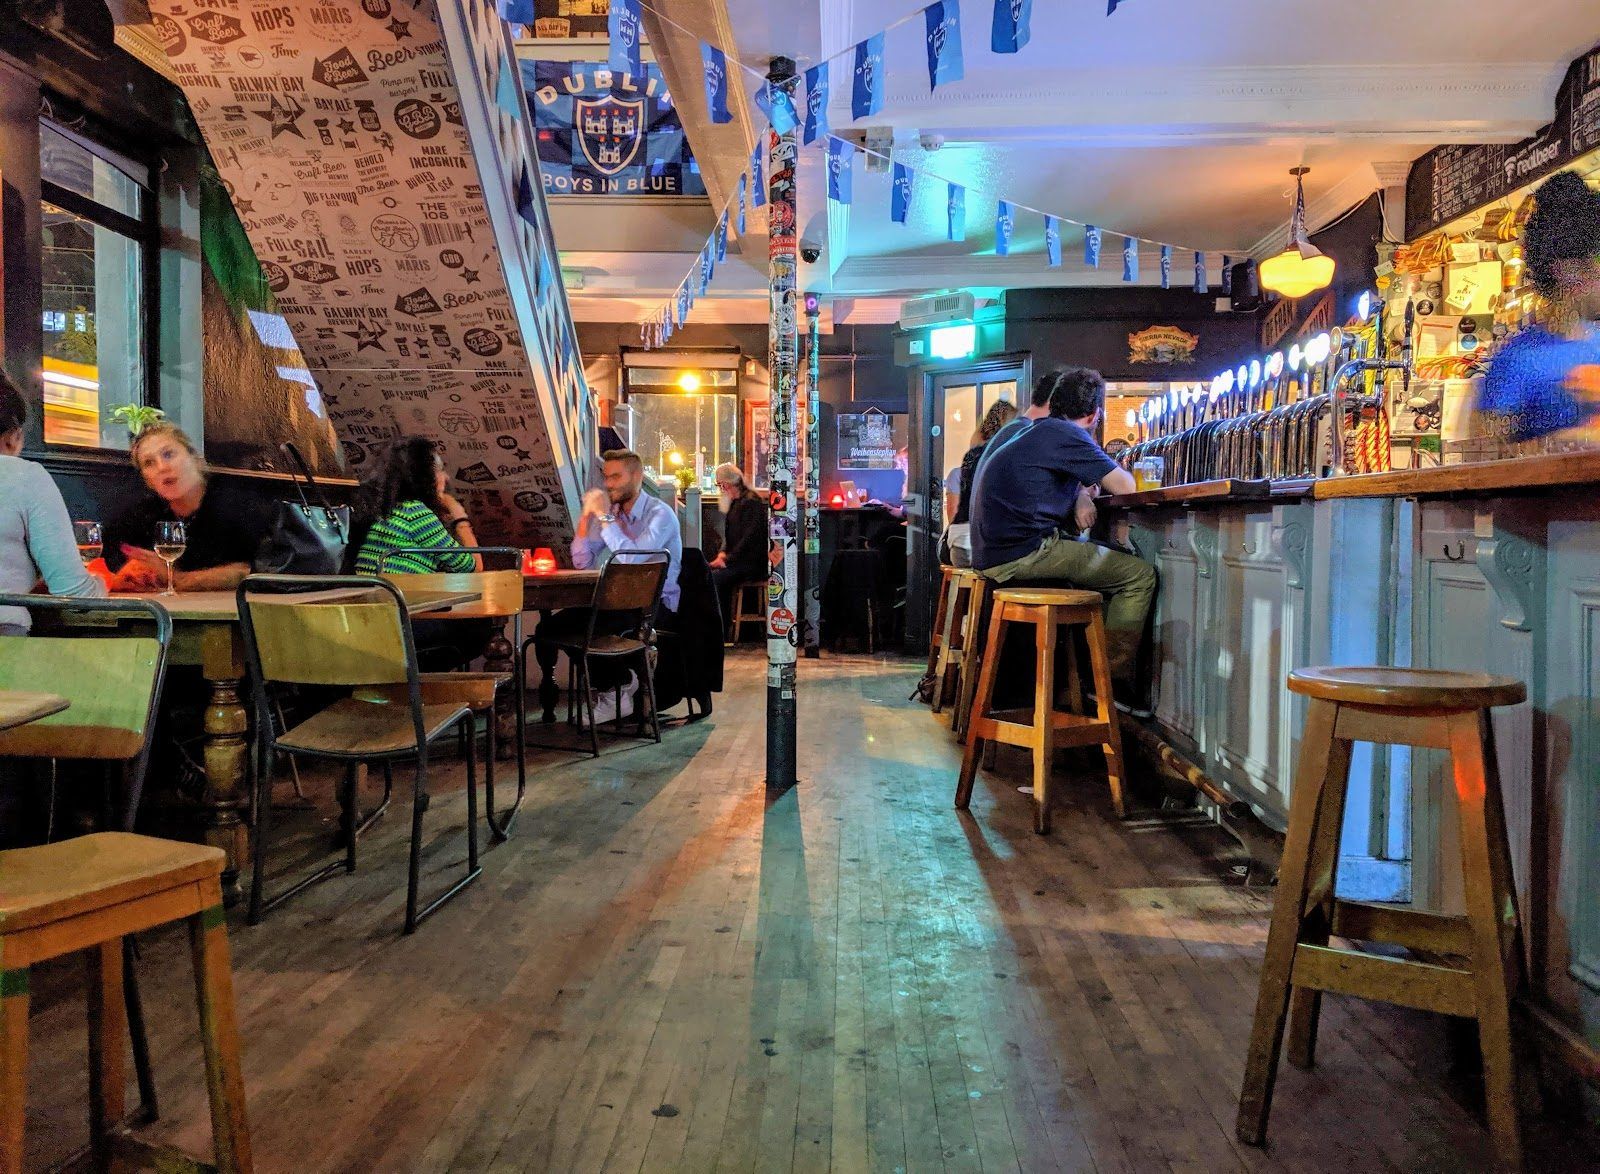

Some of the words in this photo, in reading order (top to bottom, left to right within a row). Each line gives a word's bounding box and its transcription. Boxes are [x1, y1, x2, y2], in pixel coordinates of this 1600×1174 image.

[190, 14, 226, 31] Craft
[251, 6, 295, 32] HOPS
[309, 7, 353, 25] MARIS
[208, 25, 239, 41] Beer
[415, 40, 448, 56] STORM
[366, 46, 418, 73] Beer
[228, 76, 279, 93] GALWAY
[281, 76, 306, 93] BAY
[418, 69, 454, 89] FULL
[233, 92, 272, 103] BREWERY
[313, 97, 334, 110] BAY
[421, 145, 447, 156] MARE
[322, 162, 347, 174] Beer
[354, 153, 385, 169] BEHOLD
[409, 156, 467, 169] INCOGNITA
[355, 185, 375, 196] The
[376, 179, 400, 191] Beer
[405, 171, 436, 190] BURIED
[438, 176, 454, 192] SEA
[543, 173, 594, 192] BOYS
[600, 178, 619, 192] IN
[626, 176, 677, 191] BLUE
[320, 191, 359, 206] FLAVOUR
[416, 202, 447, 211] THE
[423, 211, 449, 220] 108
[293, 236, 335, 258] SAIL
[345, 258, 383, 277] HOPS
[394, 259, 432, 272] MARIS
[442, 291, 485, 309] Beer
[323, 307, 366, 319] GALWAY
[367, 307, 389, 319] BAY
[486, 307, 514, 321] FULL
[1162, 333, 1189, 344] NEVADA
[497, 463, 533, 477] Beer
